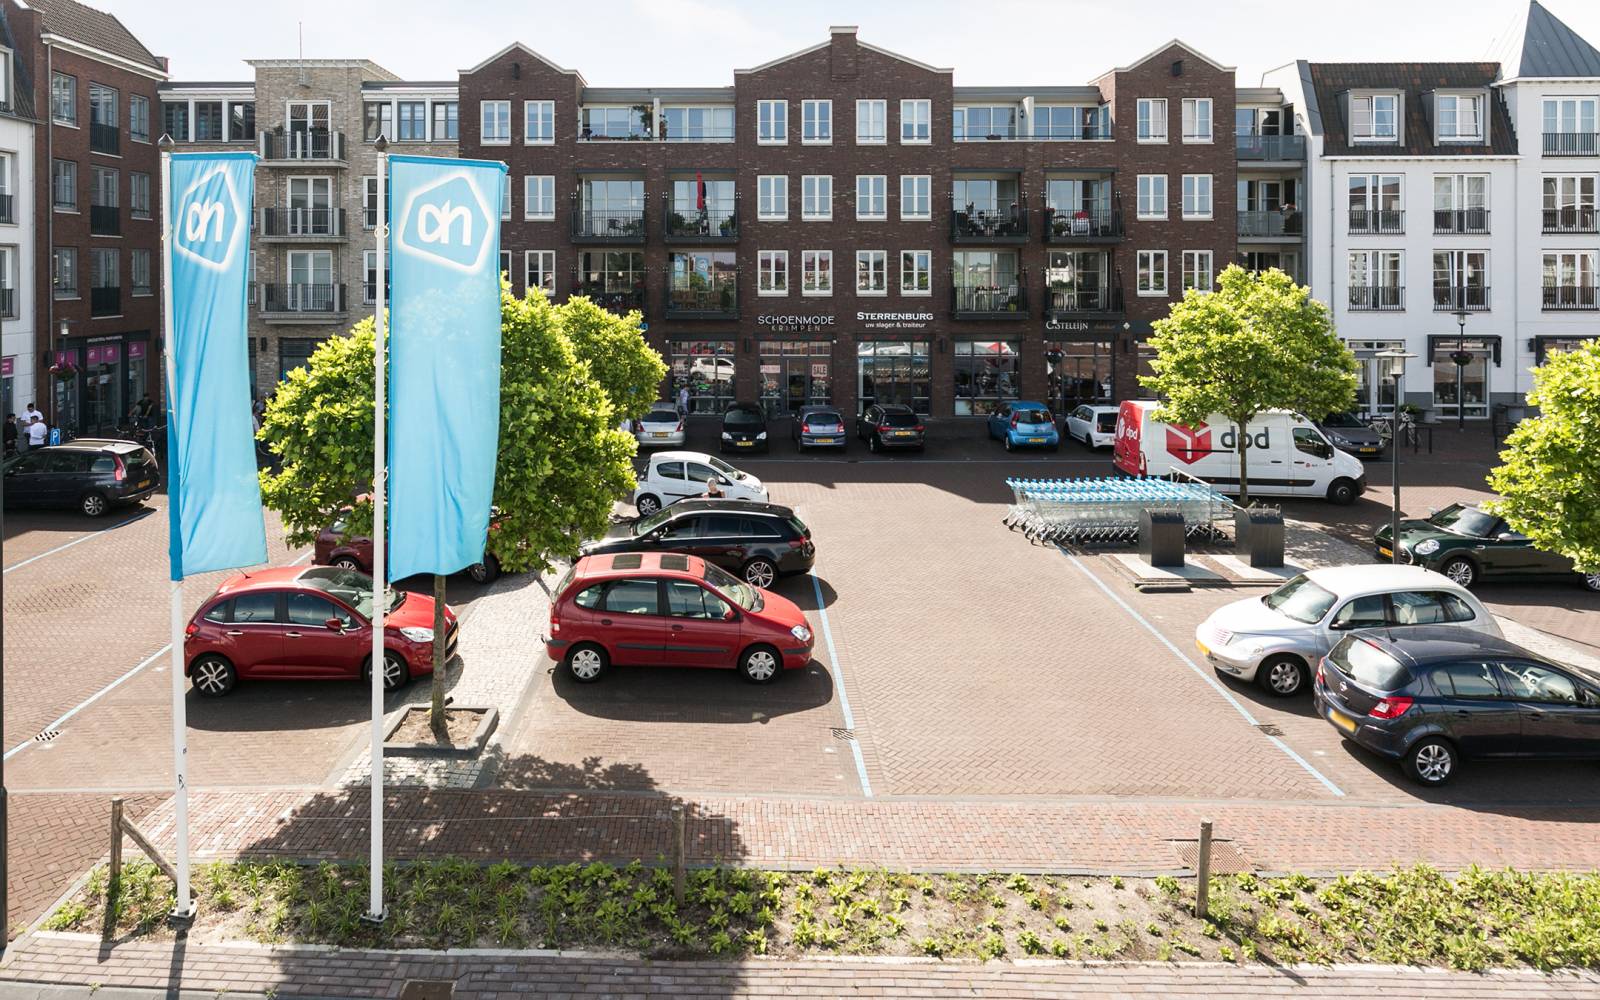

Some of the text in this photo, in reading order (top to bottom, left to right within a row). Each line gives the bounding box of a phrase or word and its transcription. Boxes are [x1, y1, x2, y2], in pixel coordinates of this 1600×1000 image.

[757, 315, 835, 325] SCHOENMODE
[856, 311, 934, 321] STERRENBURG
[876, 321, 895, 330] slager
[812, 365, 827, 376] SALE
[1125, 425, 1138, 440] dpd
